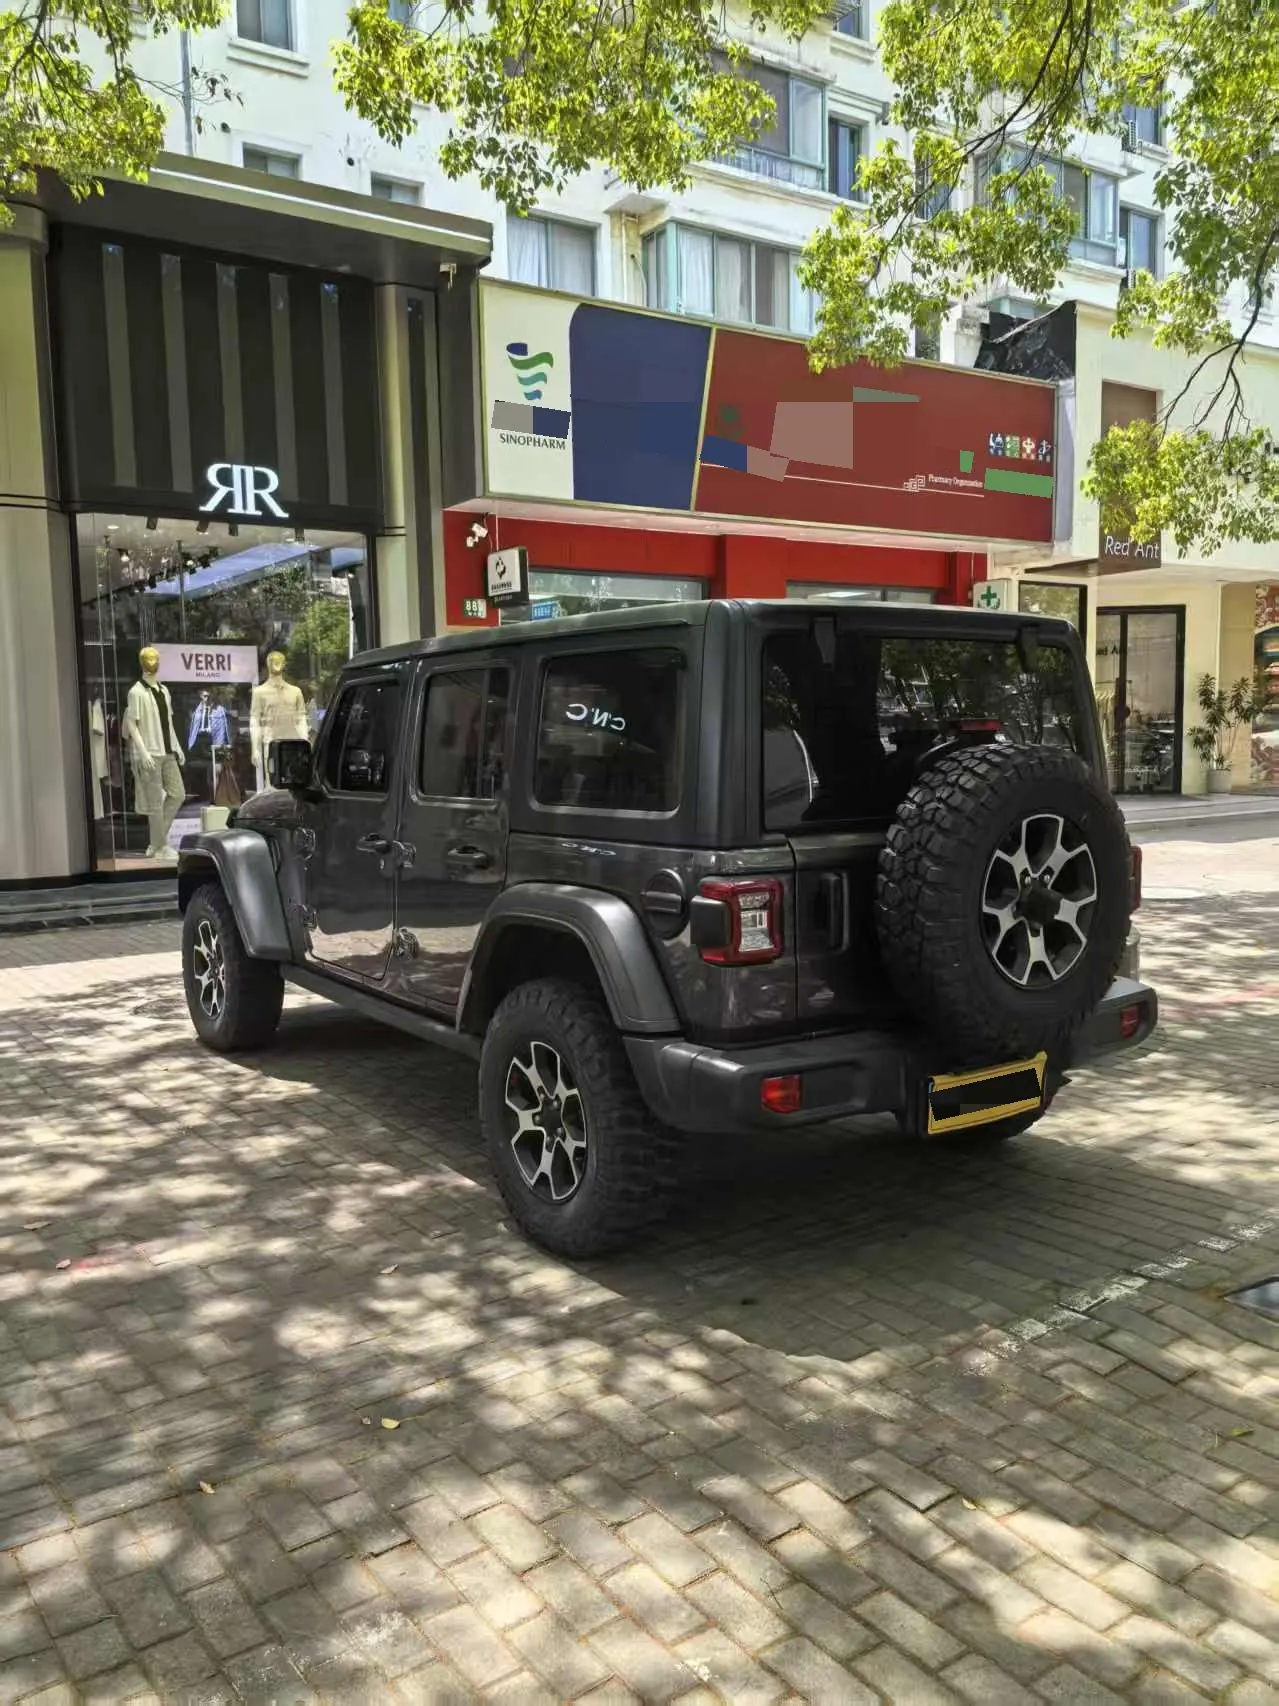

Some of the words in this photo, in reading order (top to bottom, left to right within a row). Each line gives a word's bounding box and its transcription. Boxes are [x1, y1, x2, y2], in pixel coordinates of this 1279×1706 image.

[499, 432, 566, 450] SINOPHARM
[1104, 535, 1130, 556] Red
[1134, 541, 1160, 559] Ant
[181, 652, 231, 672] VERRI
